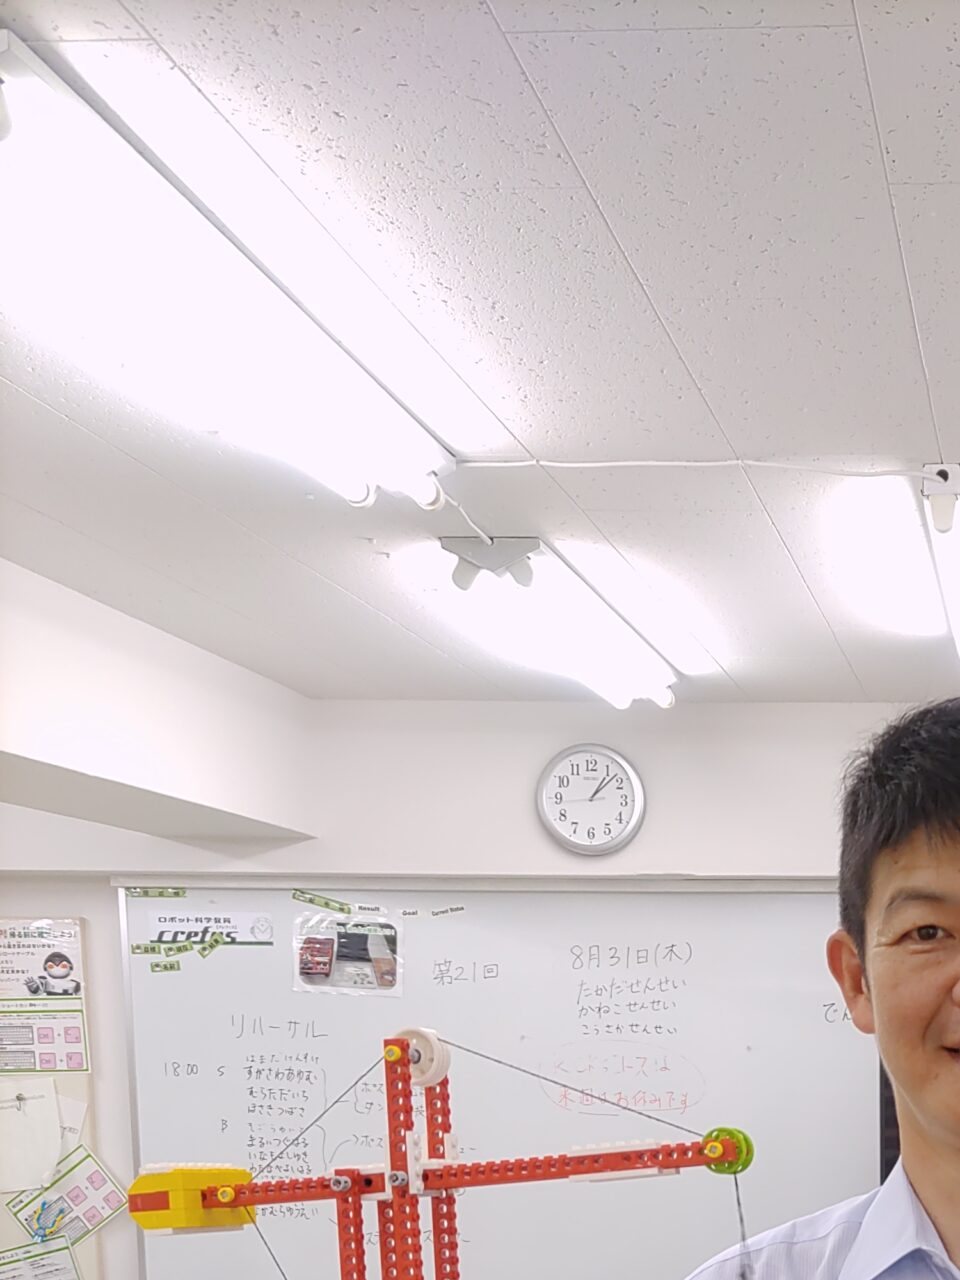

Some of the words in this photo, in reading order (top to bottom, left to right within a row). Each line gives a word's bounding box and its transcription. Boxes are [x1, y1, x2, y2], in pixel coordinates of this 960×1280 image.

[571, 763, 580, 776] 11
[585, 759, 598, 772] 12
[605, 764, 610, 777] 1
[557, 775, 569, 788] 10
[615, 777, 624, 790] 2
[554, 791, 563, 805] 9
[620, 794, 628, 807] 3
[558, 809, 567, 822] 8
[614, 811, 624, 824] 4
[571, 821, 579, 835] 7
[587, 827, 595, 840] 6
[603, 823, 611, 836] 5
[432, 958, 500, 986] 第21回
[231, 1014, 329, 1039] リハーサル
